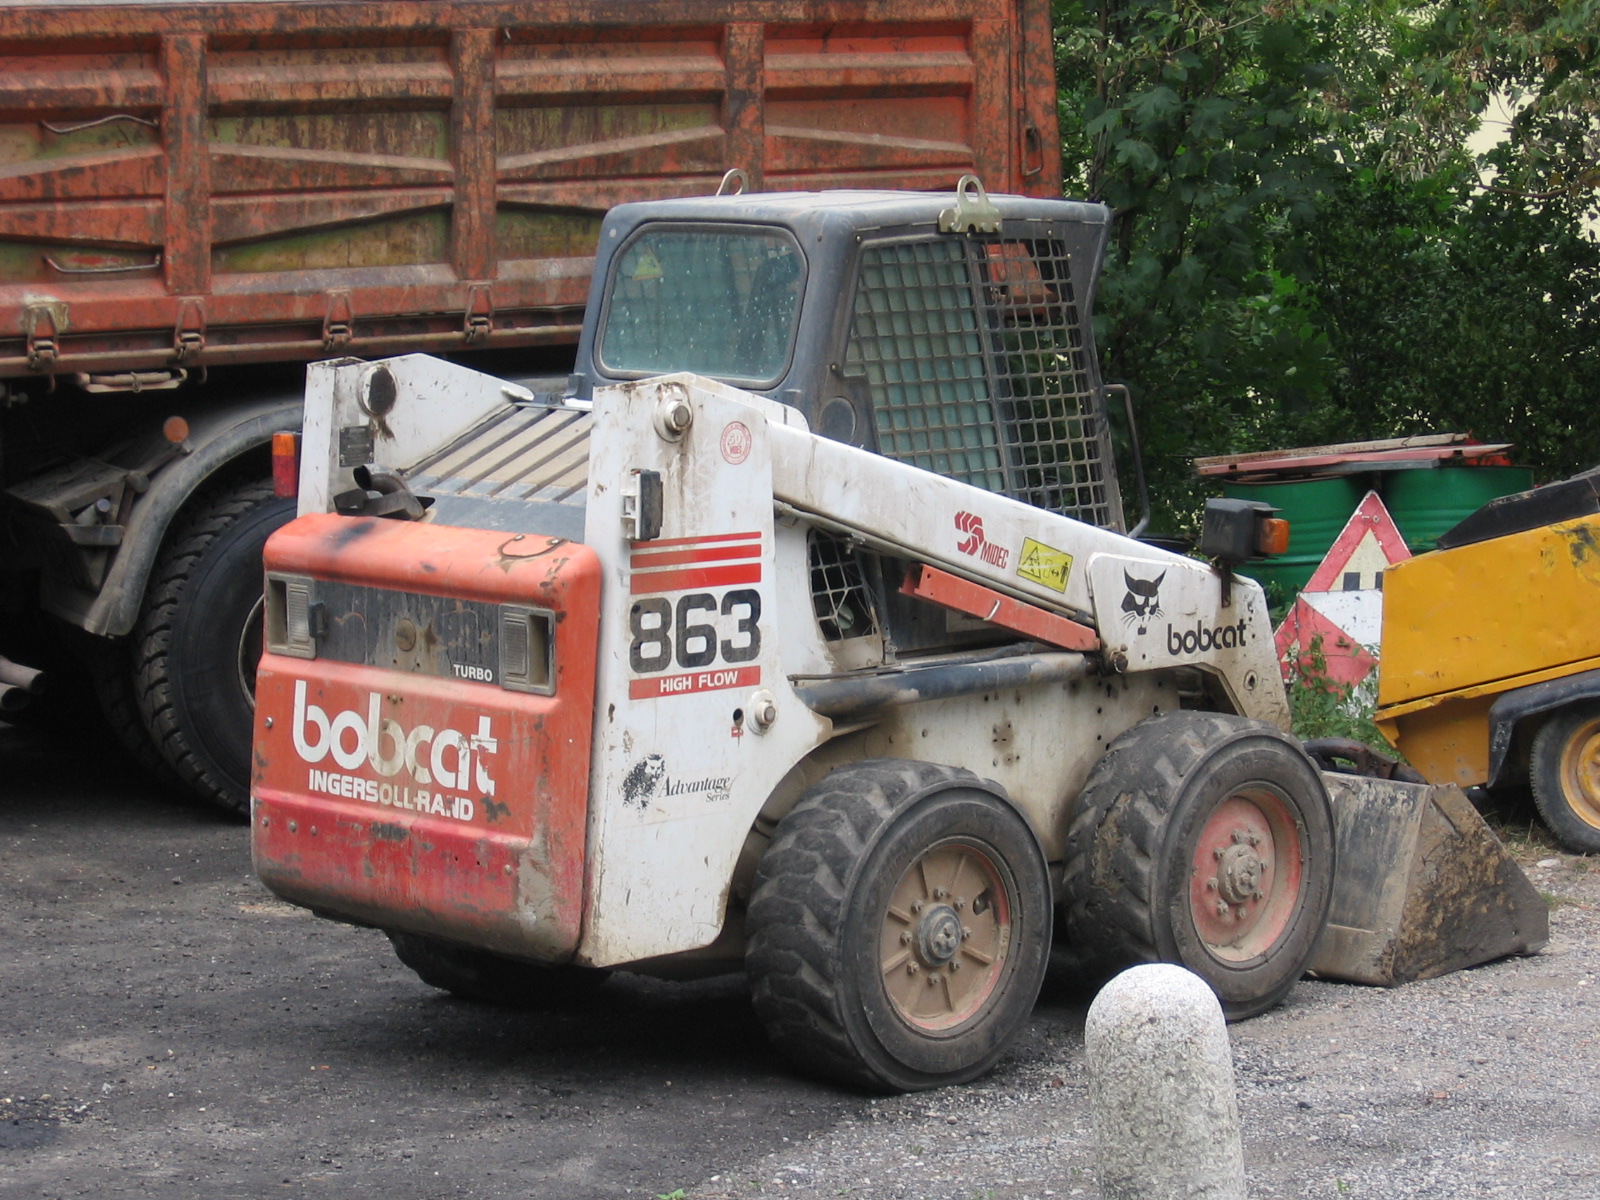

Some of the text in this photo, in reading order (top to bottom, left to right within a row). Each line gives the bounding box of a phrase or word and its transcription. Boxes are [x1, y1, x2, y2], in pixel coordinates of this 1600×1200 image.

[629, 588, 762, 674] 863
[1167, 618, 1247, 656] bobcat
[453, 663, 493, 682] TURBO
[659, 670, 738, 693] HIGH FLOW
[292, 679, 498, 797] bobcat
[657, 776, 731, 798] Advantage
[705, 791, 730, 803] Series
